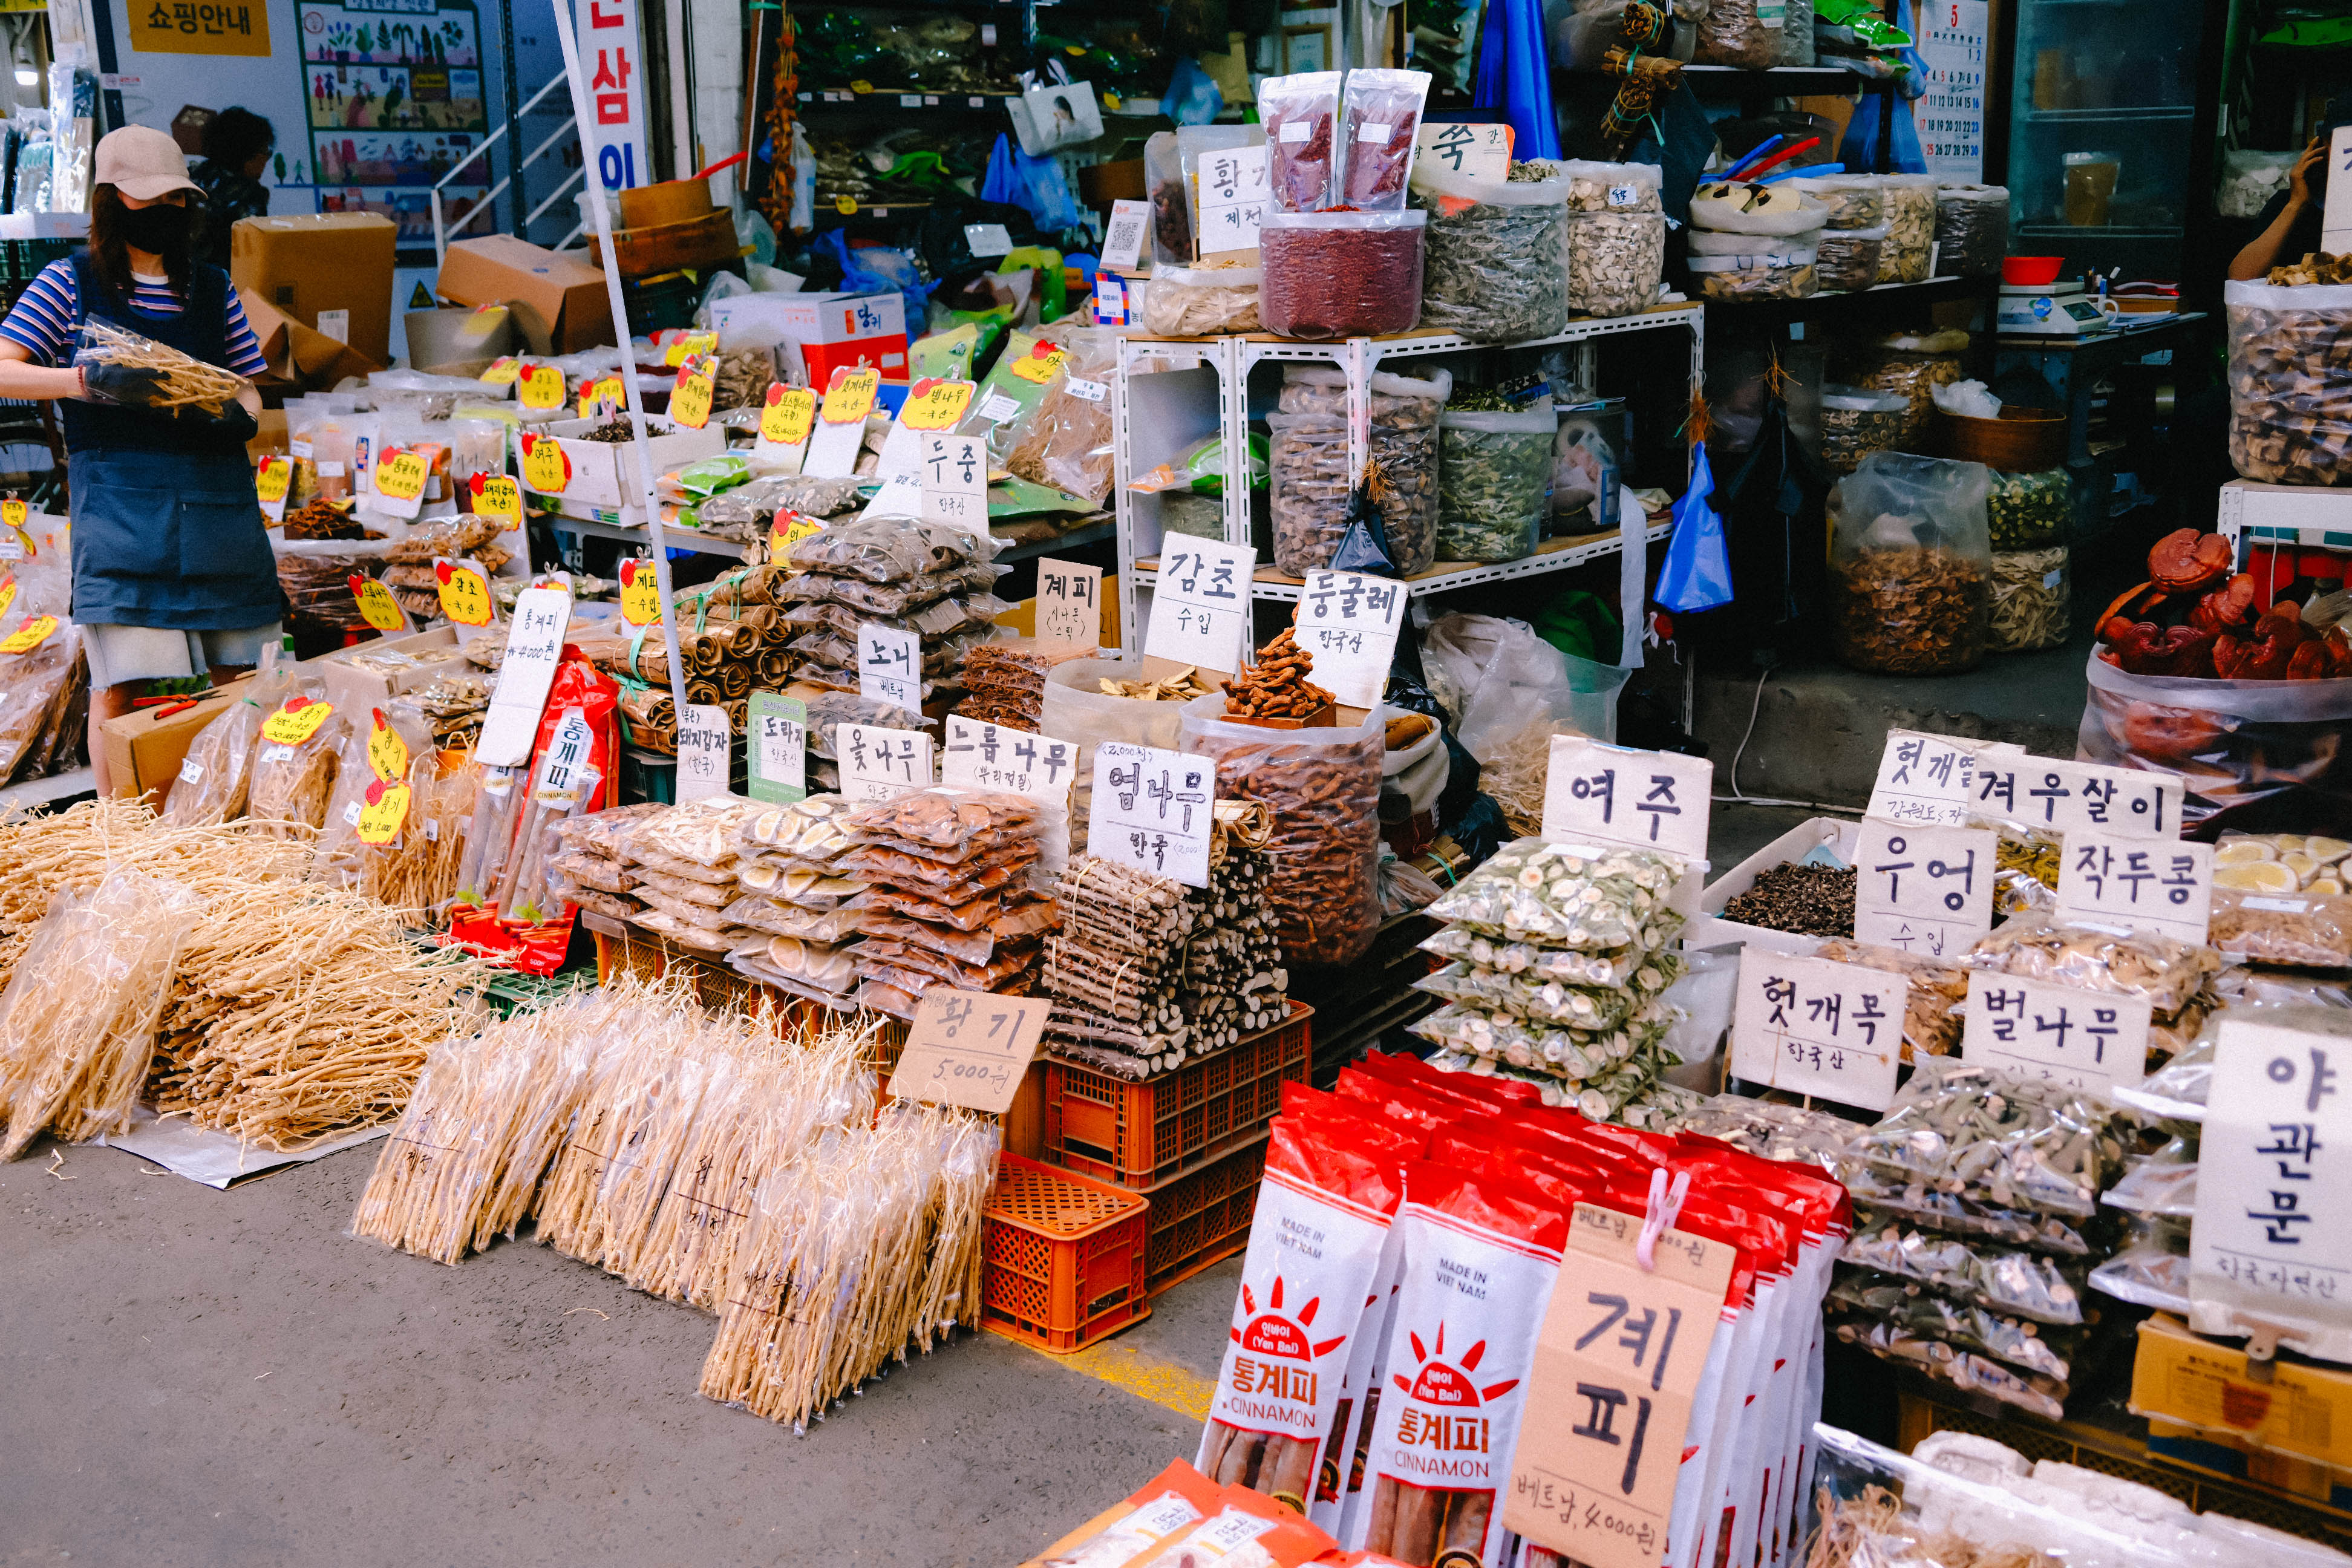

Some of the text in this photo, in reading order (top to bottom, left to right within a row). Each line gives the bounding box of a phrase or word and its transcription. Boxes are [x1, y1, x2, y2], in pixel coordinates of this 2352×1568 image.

[148, 2, 250, 35] 쇼핑안내
[1951, 4, 1958, 27] 5
[1976, 49, 1981, 60] 2
[1932, 70, 1936, 81] 4
[1941, 70, 1945, 82] 5
[1950, 71, 1953, 83] 6
[1967, 73, 1971, 84] 8
[1975, 73, 1979, 85] 9
[1921, 94, 1979, 109] 10 11 12 13 14 15 16
[1919, 119, 1979, 132] 17 18 19 20 21 22 23
[1431, 125, 1475, 171] 쑥
[1935, 144, 1942, 155] 26
[1944, 144, 1952, 155] 27
[1953, 145, 1960, 156] 28
[1962, 145, 1969, 156] 29
[1971, 145, 1978, 157] 30
[535, 446, 554, 464] 여주
[928, 440, 977, 483] 두충
[939, 497, 965, 516] 한국산
[456, 577, 478, 596] 감초
[637, 573, 658, 592] 계피
[1044, 573, 1093, 609] 계피
[1169, 553, 1236, 599] 감초
[1308, 573, 1397, 624] 둥굴레
[1178, 607, 1211, 635] 수입
[867, 639, 910, 676] 노니
[1319, 630, 1363, 654] 한국산
[880, 682, 904, 701] 베트남
[679, 728, 728, 751] 돼지감자
[765, 716, 803, 750] 도라지
[546, 716, 585, 789] 통계피
[770, 747, 797, 768] 한국산
[849, 728, 916, 782] 옻나무
[948, 725, 1067, 784] 느릅나무
[537, 791, 572, 800] CINNAMON
[1109, 762, 1206, 833] 엄나무
[1571, 769, 1682, 841] 여주
[1978, 771, 2164, 833] 겨우살이
[1130, 832, 1169, 871] 한국
[1875, 837, 1975, 911] 우엉
[2076, 845, 2199, 905] 작두콩
[1891, 923, 1944, 956] 수입
[937, 996, 1026, 1050] 황기
[1762, 975, 1886, 1046] 헛개목
[1984, 988, 2119, 1065] 벌나무
[1787, 1042, 1844, 1072] 한국산
[2247, 1047, 2337, 1244] 야관문
[1281, 1216, 1325, 1243] MADE IN
[1436, 1270, 1486, 1300] VIET NAM
[1439, 1258, 1487, 1284] MADE IN
[1232, 1355, 1318, 1406] 통계피
[1575, 1291, 1682, 1495] 계피
[1231, 1397, 1316, 1428] CINNAMON
[1397, 1406, 1489, 1454] 통계피
[1394, 1451, 1489, 1478] CINNAMON
